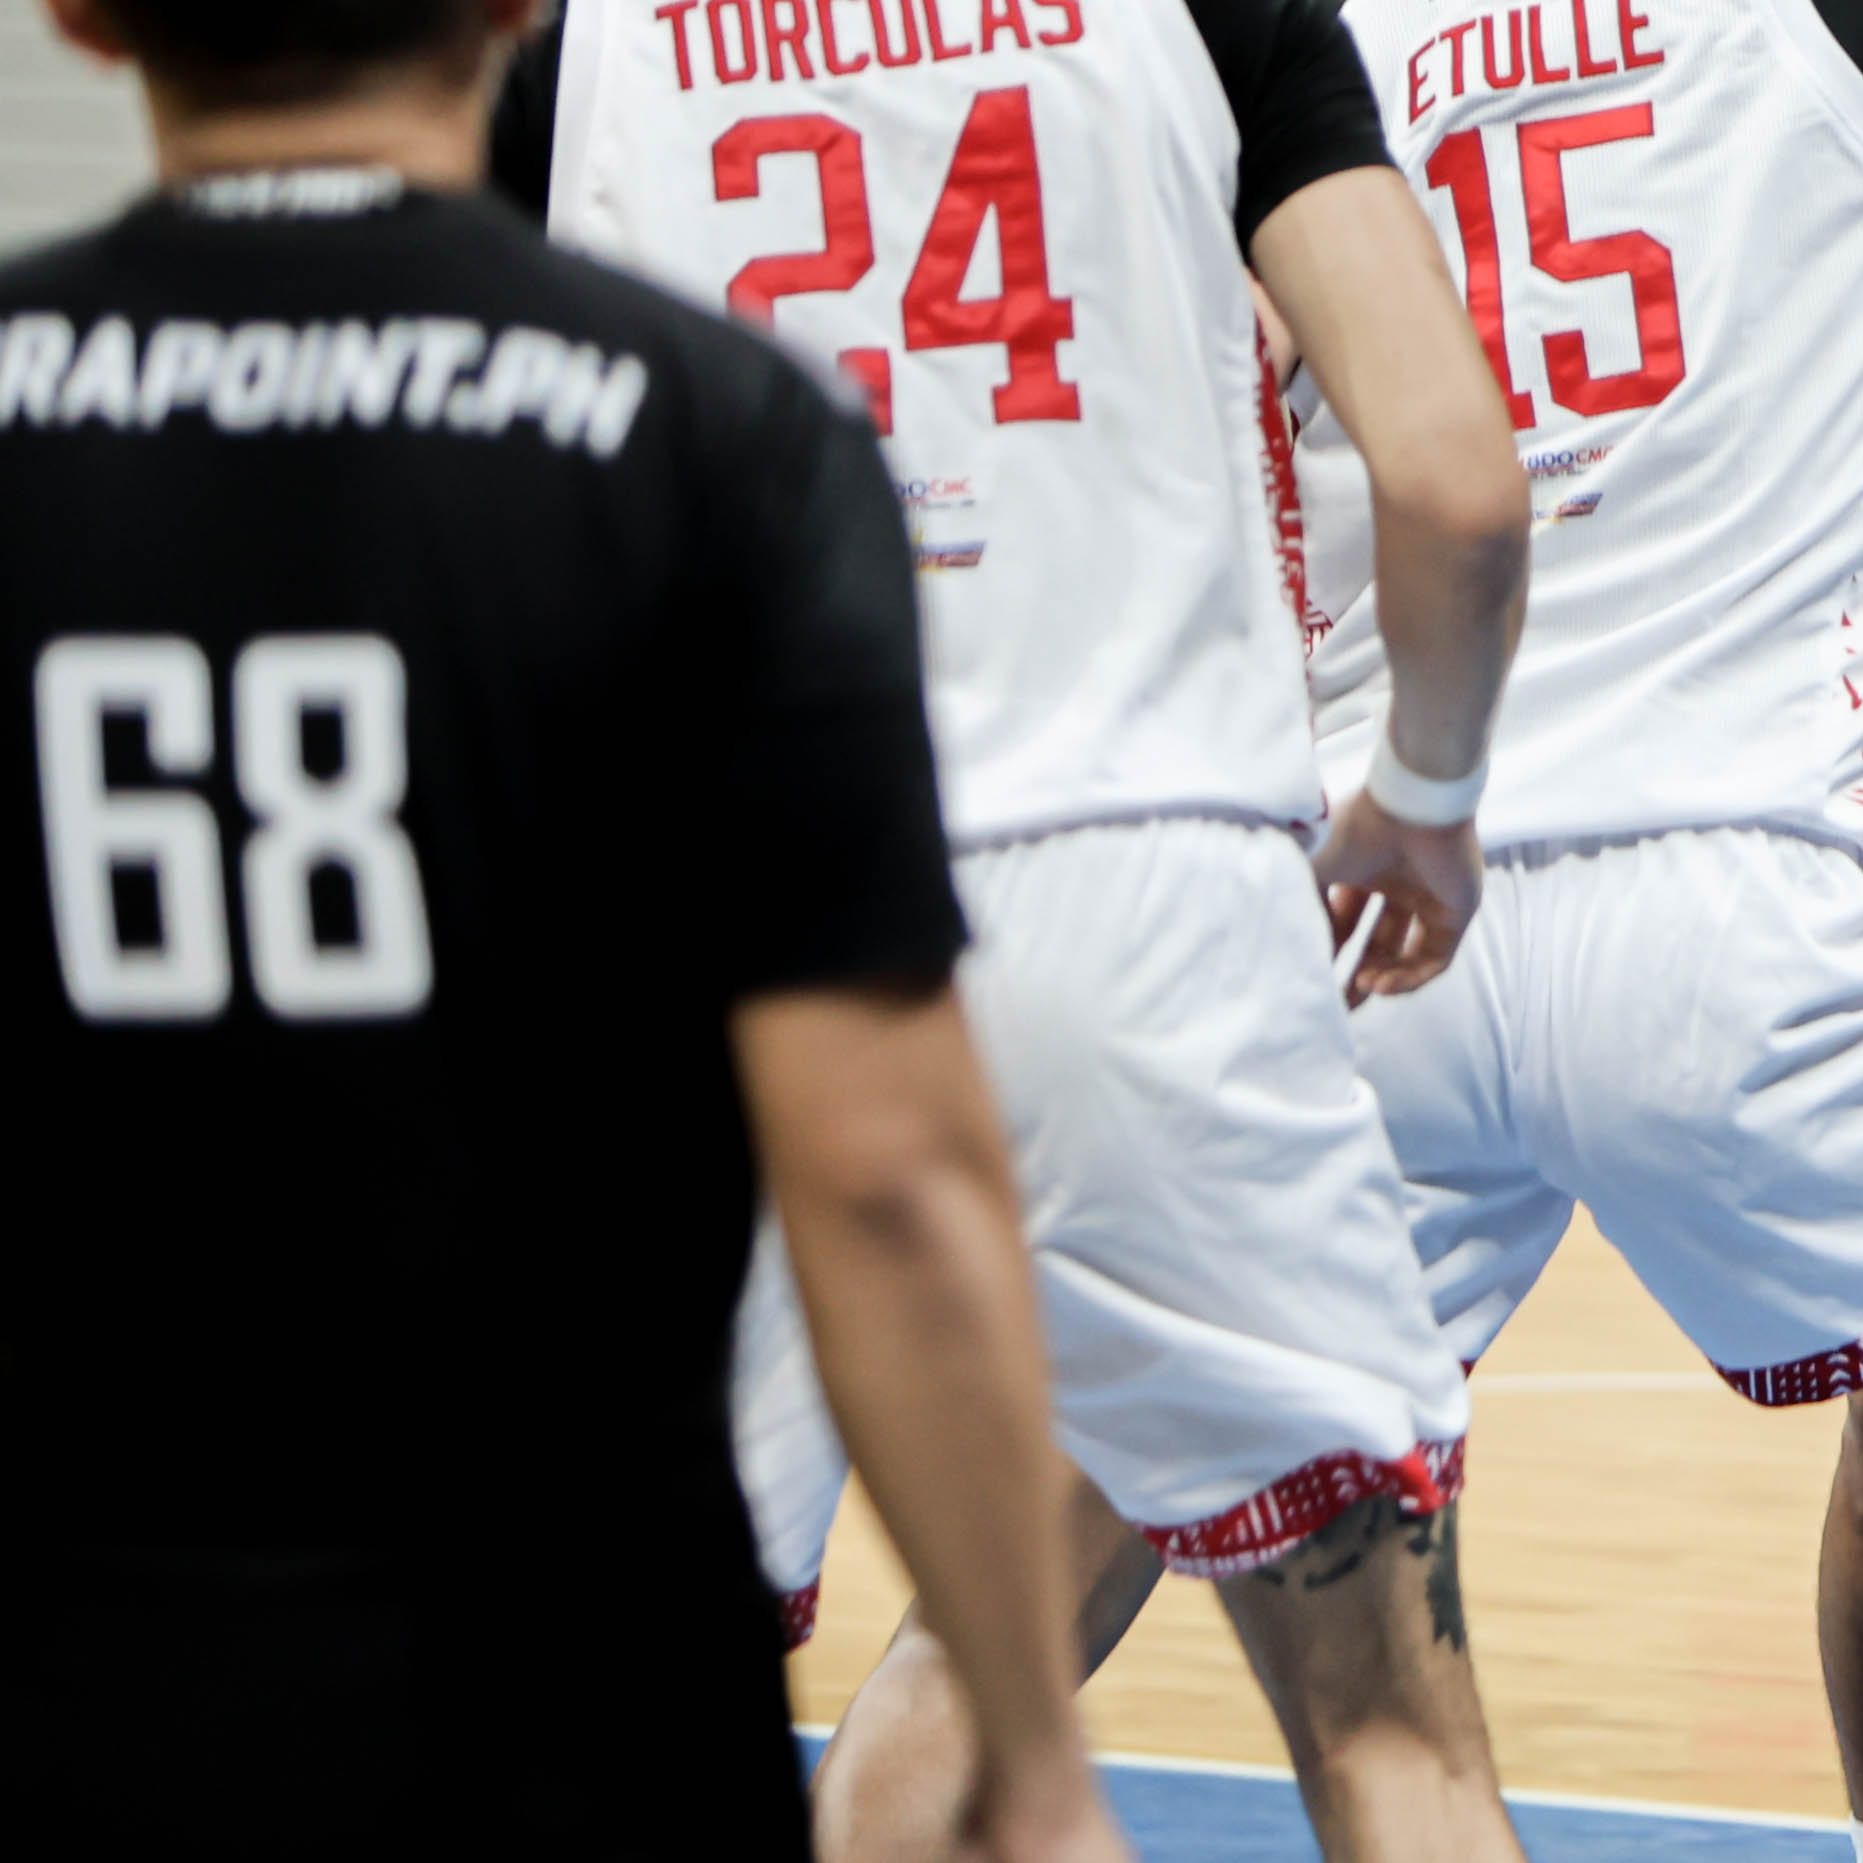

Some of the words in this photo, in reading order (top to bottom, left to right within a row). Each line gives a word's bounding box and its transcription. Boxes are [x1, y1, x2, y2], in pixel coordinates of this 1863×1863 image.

[0, 310, 649, 458] RAPOINT.PH
[711, 84, 1082, 436] 24
[1426, 102, 1686, 430] 15
[33, 631, 435, 1024] 68
